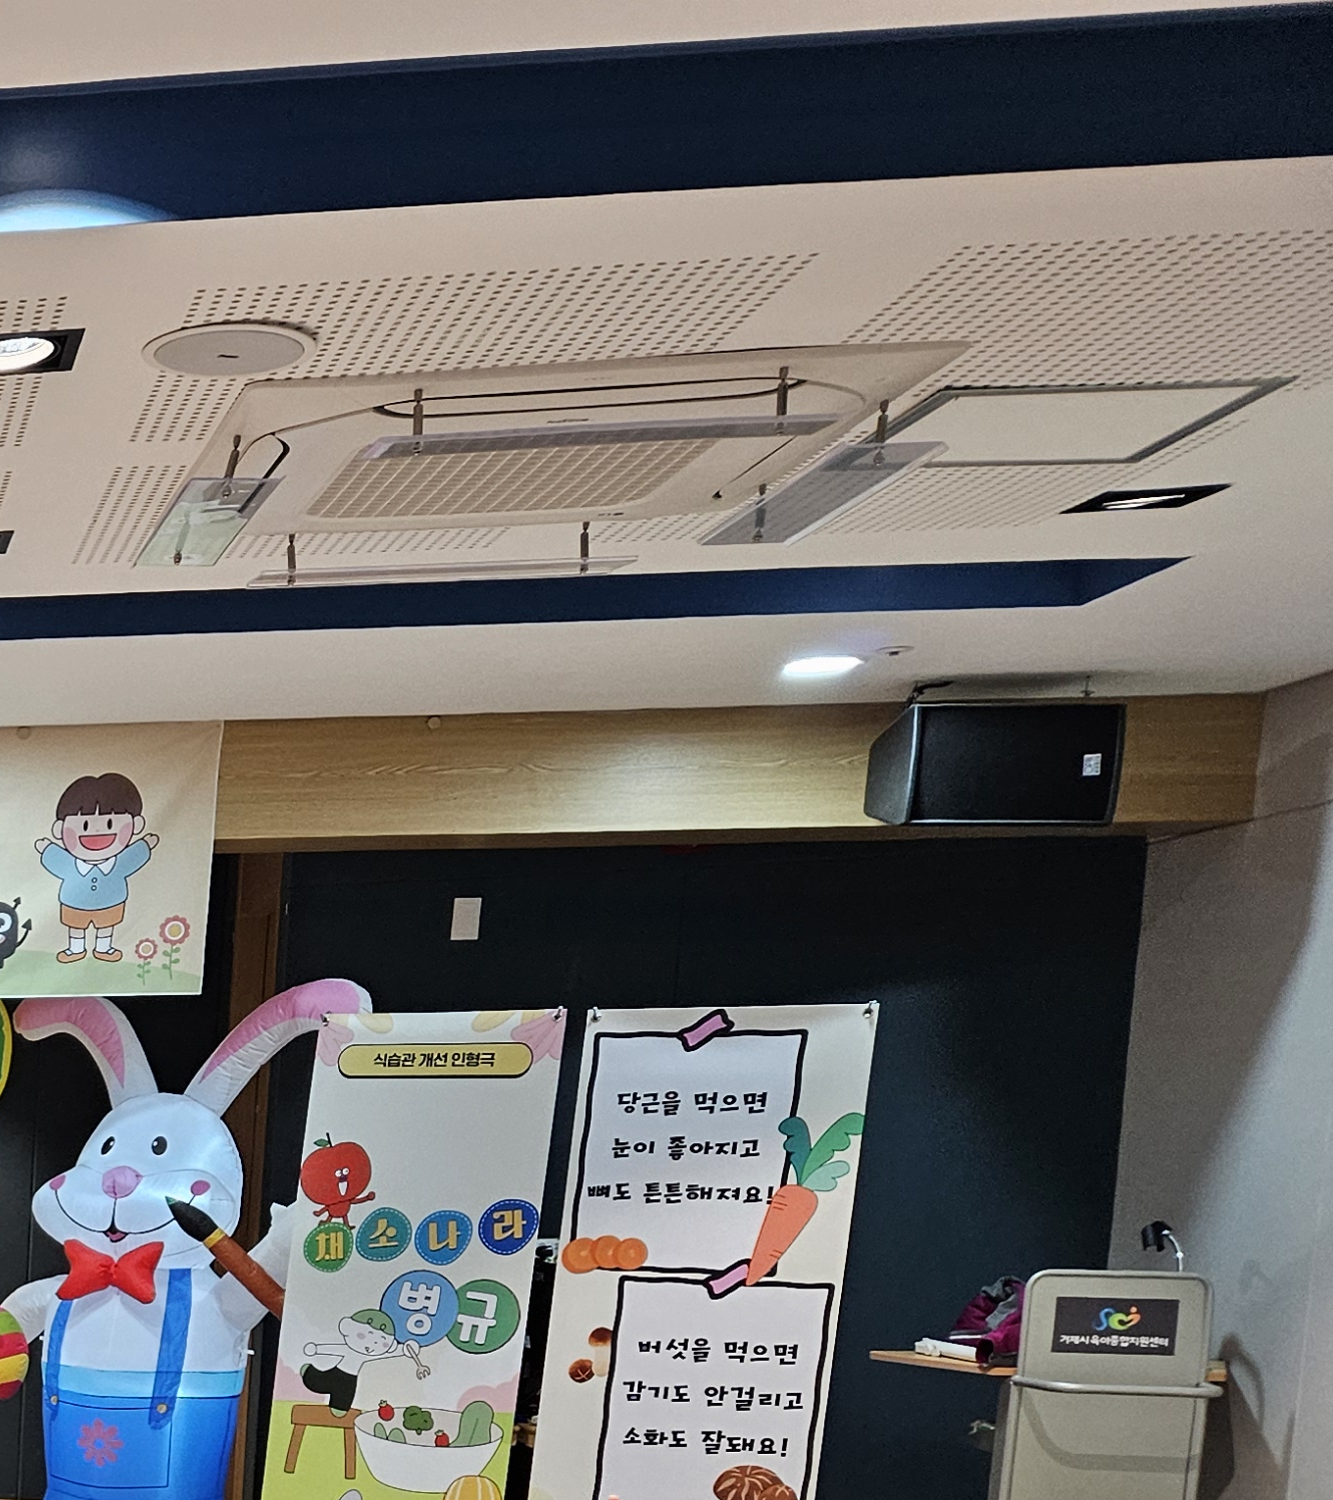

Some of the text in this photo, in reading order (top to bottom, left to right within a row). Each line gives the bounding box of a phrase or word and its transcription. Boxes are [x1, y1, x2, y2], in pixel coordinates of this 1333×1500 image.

[373, 1051, 496, 1068] 식습관 개선 인형극
[617, 1090, 768, 1117] 당근을 먹으면
[611, 1135, 761, 1161] 눈이 좋아지고
[587, 1182, 775, 1205] 뼈도 튼튼해져요!
[397, 1280, 498, 1346] 병규
[637, 1337, 799, 1366] 버섯을 먹으면
[622, 1380, 804, 1412] 감기도 안걸리고
[622, 1426, 789, 1458] 소화도 잘돼요!
